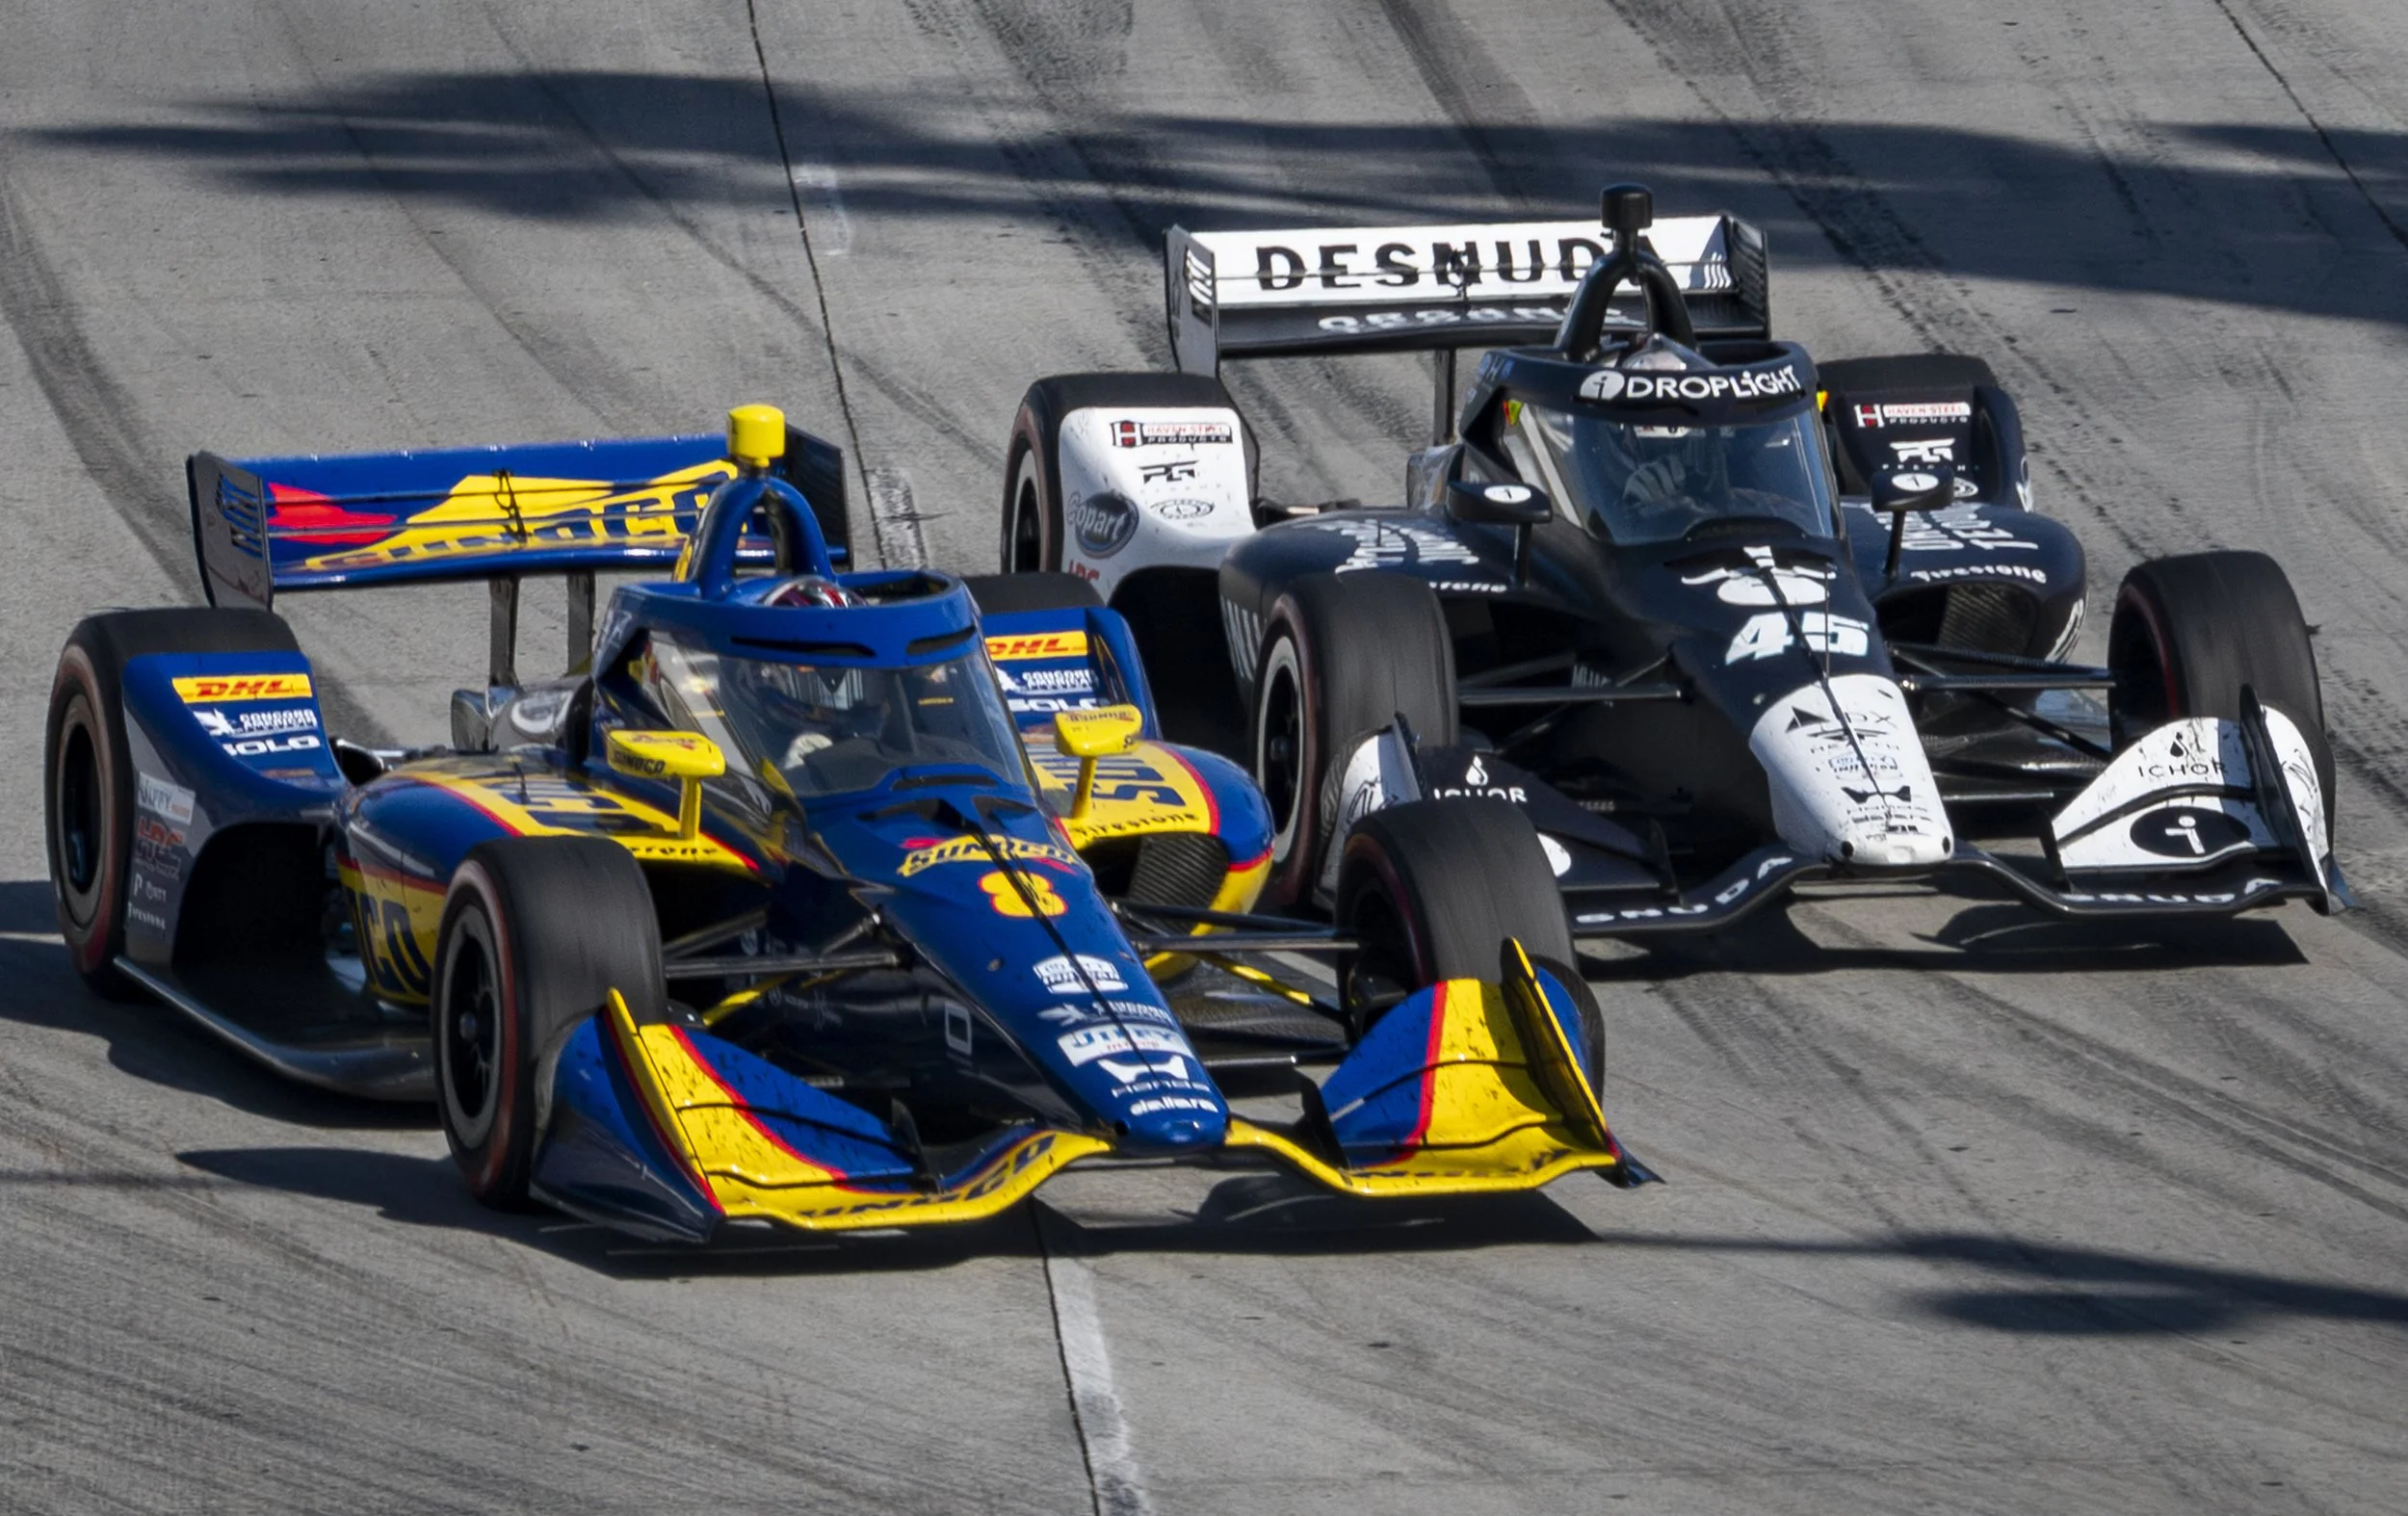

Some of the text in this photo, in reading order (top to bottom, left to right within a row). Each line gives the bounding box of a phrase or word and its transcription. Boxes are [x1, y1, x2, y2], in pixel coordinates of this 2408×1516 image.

[1627, 364, 1802, 399] DROPLIGHT
[1066, 490, 1128, 541] Copart
[1910, 564, 2047, 584] Firestone
[1725, 610, 1870, 666] 45
[196, 679, 291, 696] DHL
[2137, 759, 2228, 777] ICHOR
[979, 870, 1067, 918] 8
[1129, 1095, 1219, 1116] dallara
